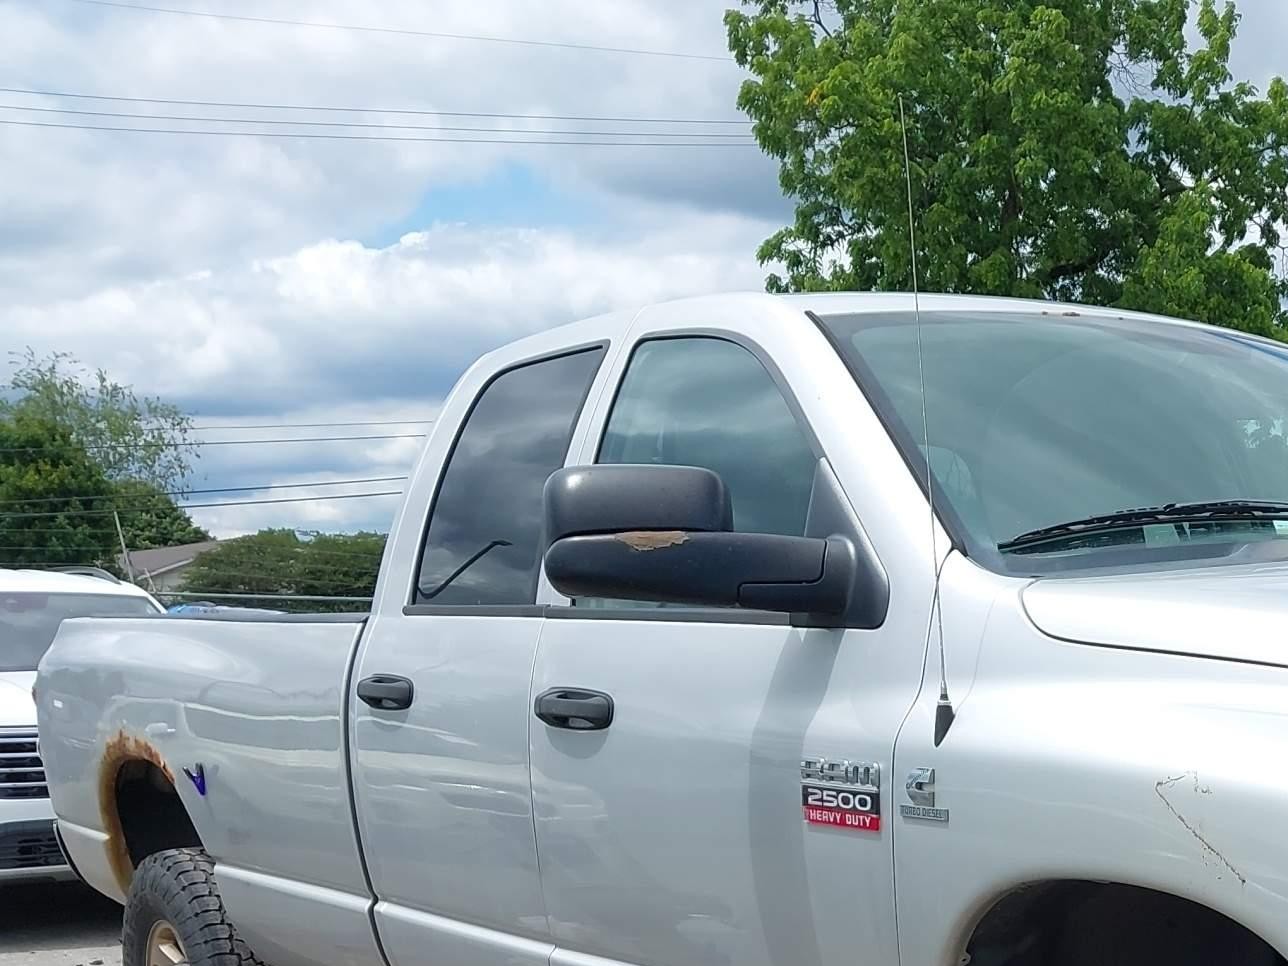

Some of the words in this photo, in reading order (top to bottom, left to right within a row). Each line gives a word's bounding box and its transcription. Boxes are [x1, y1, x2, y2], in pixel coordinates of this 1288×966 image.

[807, 788, 872, 811] 2500
[809, 809, 842, 824] HEAVY
[845, 814, 871, 827] DUTY
